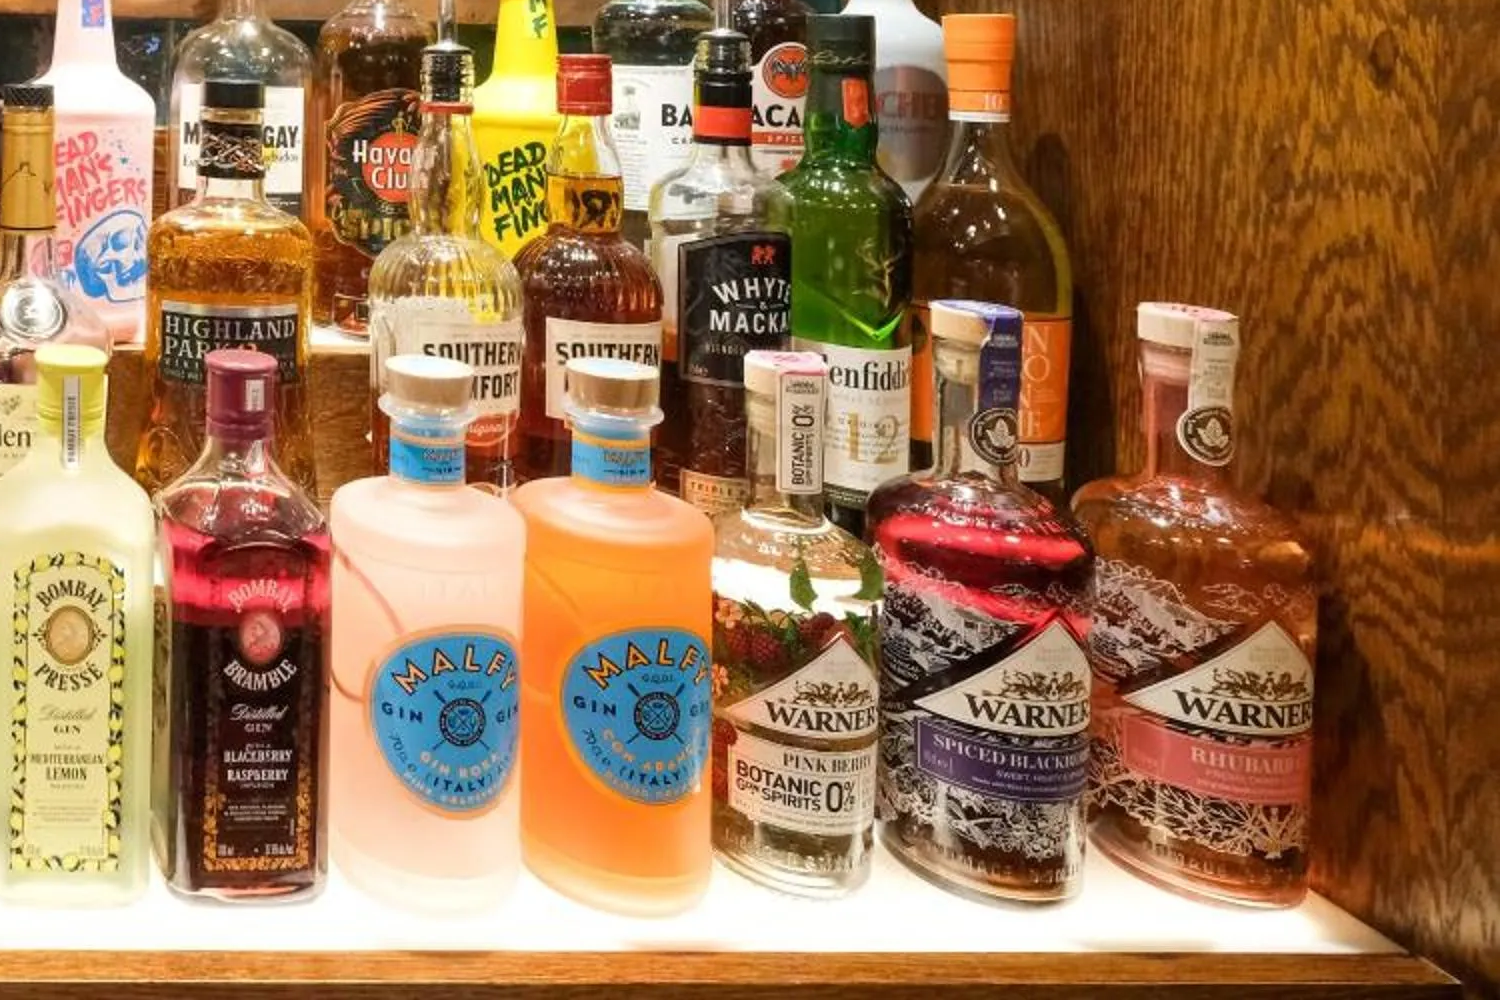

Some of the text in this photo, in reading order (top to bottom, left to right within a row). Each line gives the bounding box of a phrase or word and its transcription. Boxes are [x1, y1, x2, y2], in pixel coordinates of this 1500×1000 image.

[55, 131, 99, 168] EAD
[264, 126, 299, 149] GAY
[353, 139, 412, 164] Hava
[484, 141, 547, 187] DEAD
[371, 170, 410, 190] Clu
[490, 163, 547, 213] MAN
[165, 315, 295, 341] HIGHLAND
[709, 309, 792, 334] MACKA
[470, 371, 518, 401] FORT
[829, 360, 909, 391] enfiddi
[791, 431, 805, 485] BOTANIC
[35, 579, 109, 613] BOMBAY
[228, 578, 299, 614] BOMBAY
[223, 658, 298, 691] BRAMBLE
[392, 643, 517, 696] MALFY
[582, 638, 708, 691] MALFY
[229, 703, 289, 723] Distilled
[381, 701, 423, 724] GIN
[573, 695, 617, 717] GIN
[765, 699, 879, 733] WARNER
[964, 693, 1090, 729] WARNER
[1173, 690, 1312, 729] WARNER
[53, 725, 81, 735] GIN
[244, 723, 273, 733] GIN
[224, 749, 293, 763] BLACKBERRY
[784, 752, 871, 773] PINK BERRY
[932, 734, 1006, 766] SPICED
[46, 765, 88, 781] LEMON
[227, 768, 289, 782] RASPBERRY
[737, 759, 822, 797] BOTANIC
[826, 781, 855, 813] 0%
[762, 787, 822, 813] SPIRITS
